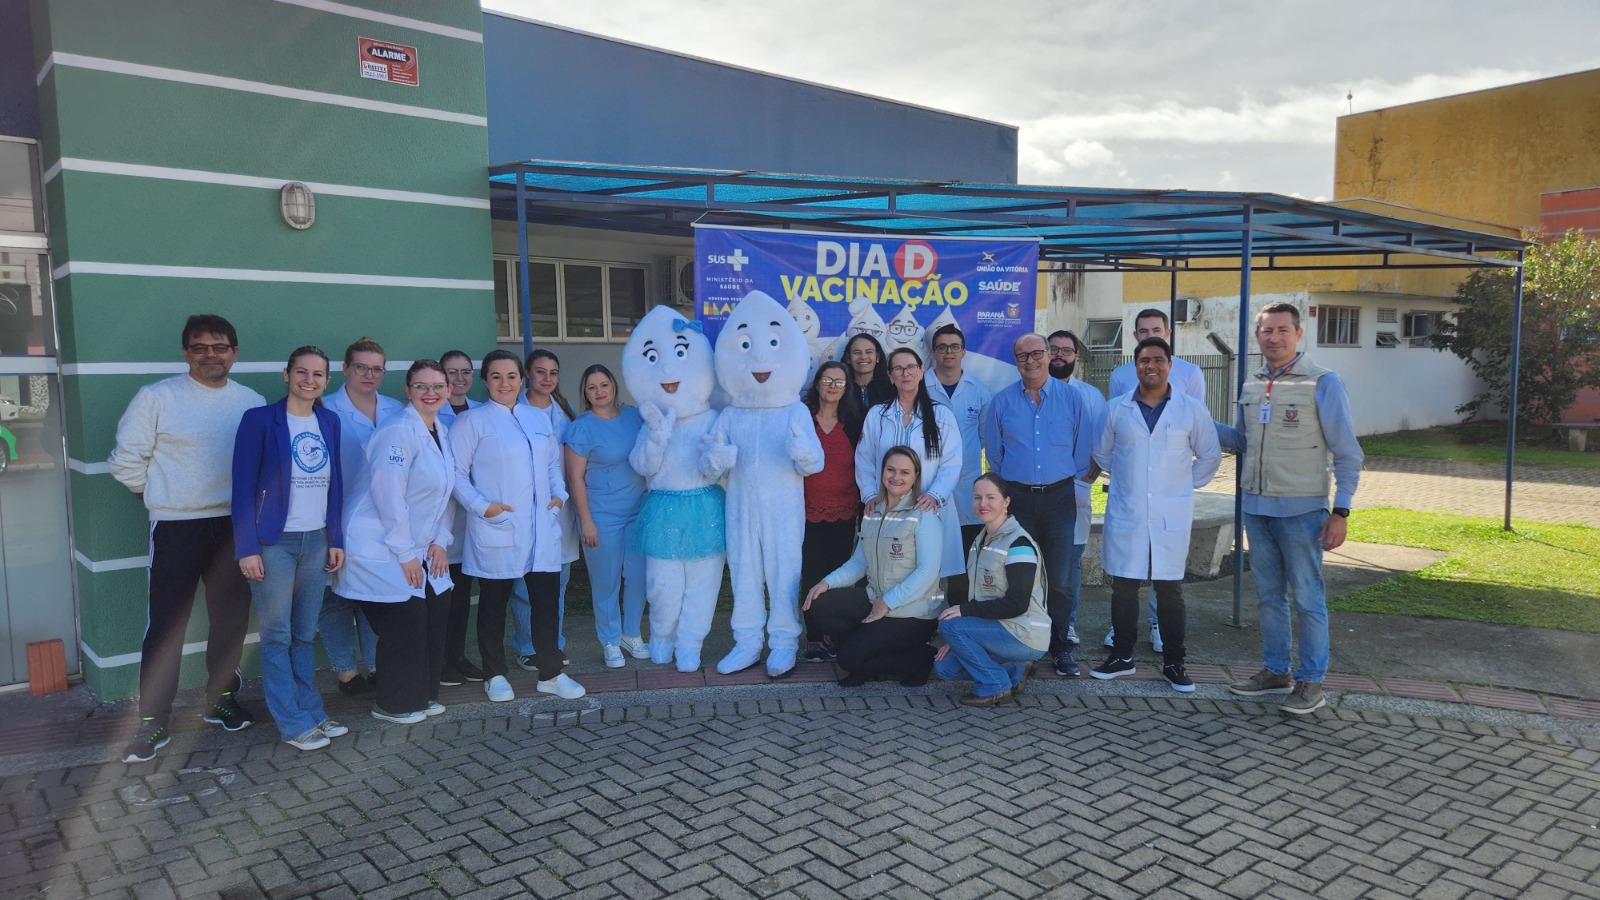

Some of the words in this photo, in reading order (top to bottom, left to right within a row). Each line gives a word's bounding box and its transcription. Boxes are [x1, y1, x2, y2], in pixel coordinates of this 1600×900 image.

[371, 47, 407, 62] ALARME
[707, 254, 726, 264] SUS
[816, 240, 891, 278] DIA
[903, 244, 934, 279] D
[1005, 265, 1029, 273] VITÓRIA
[978, 279, 1021, 292] SAÚDE
[779, 273, 969, 313] VACINAÇÃO
